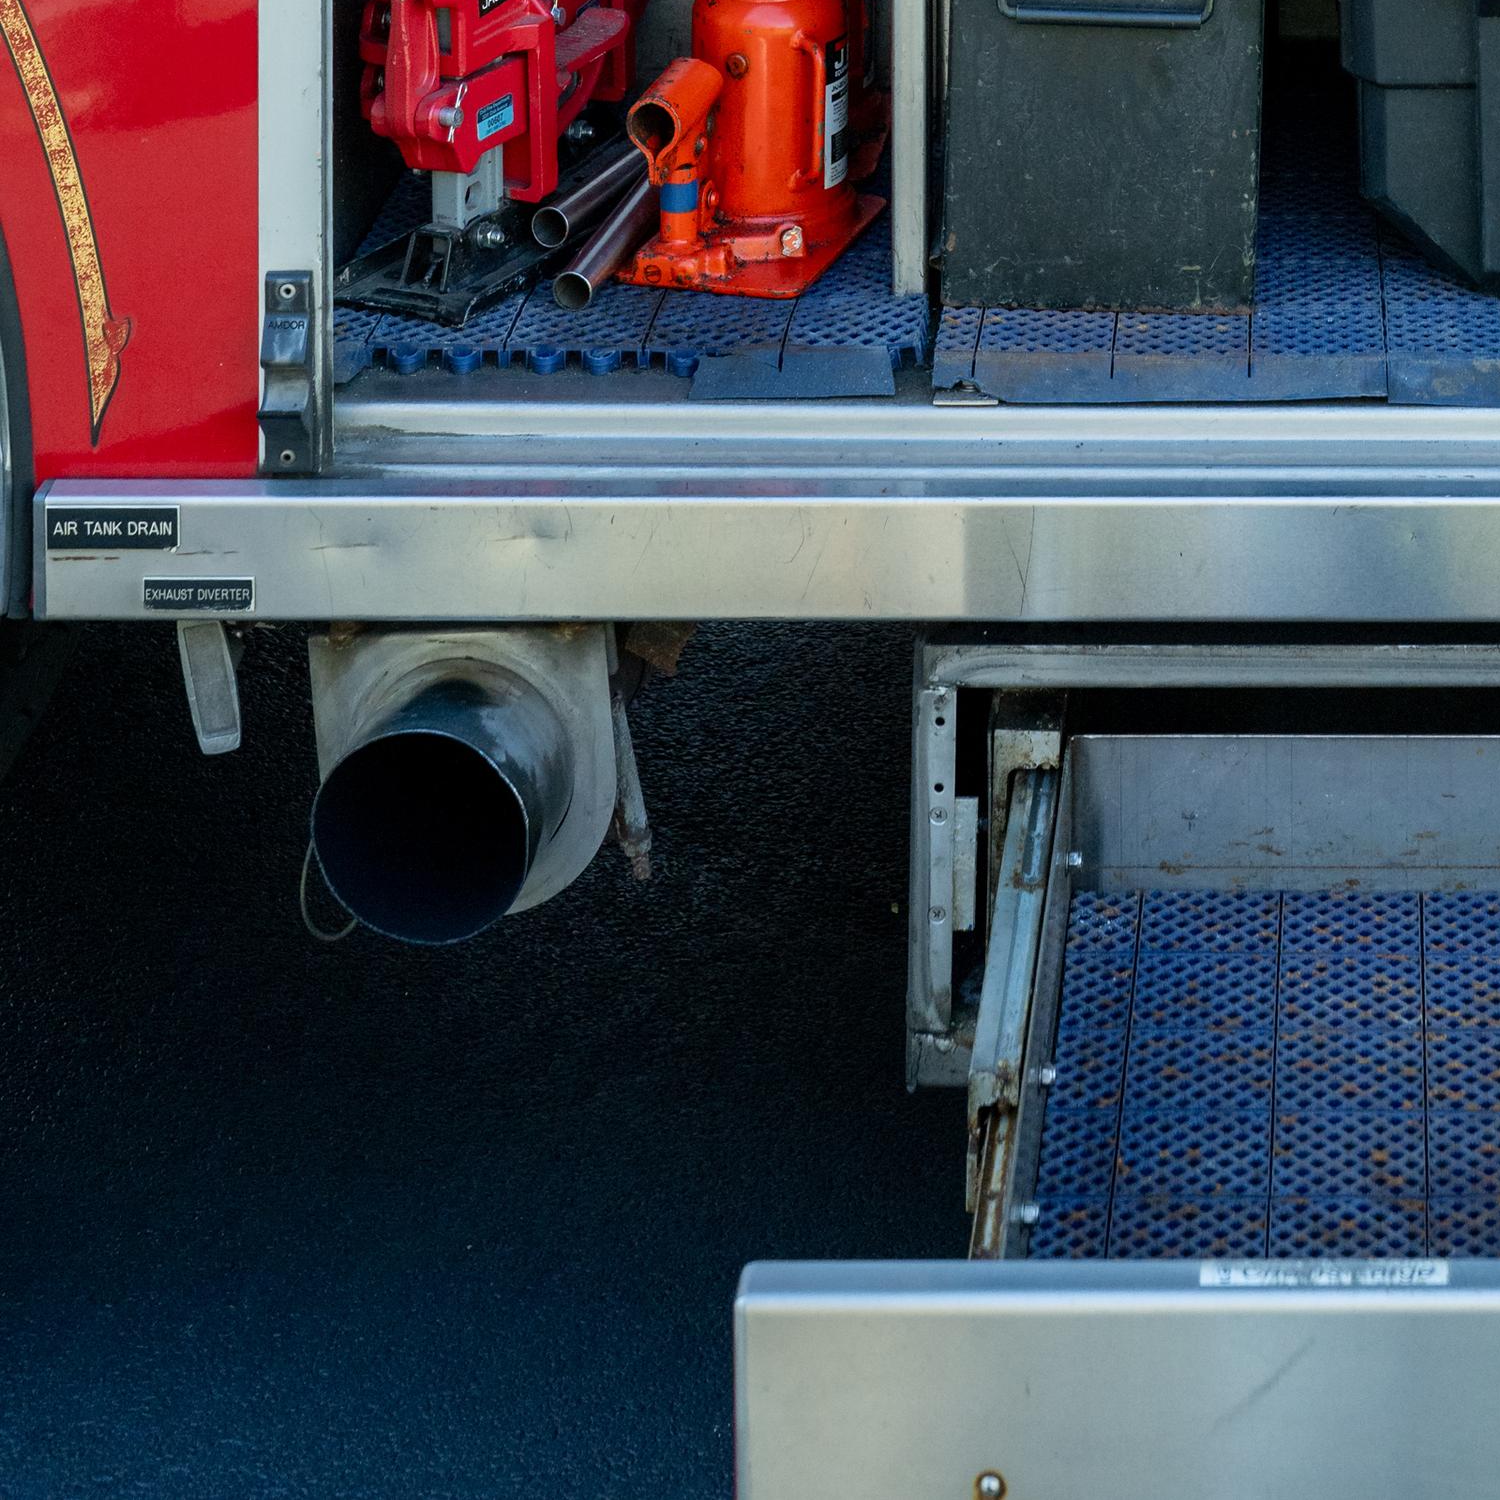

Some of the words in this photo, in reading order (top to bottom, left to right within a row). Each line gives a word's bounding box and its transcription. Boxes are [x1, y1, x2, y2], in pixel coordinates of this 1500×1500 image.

[53, 520, 78, 536] AIR
[83, 520, 123, 536] TANK
[127, 520, 173, 536] DRAIN
[145, 588, 194, 601] EXHAUST
[197, 588, 250, 601] DIVERTER
